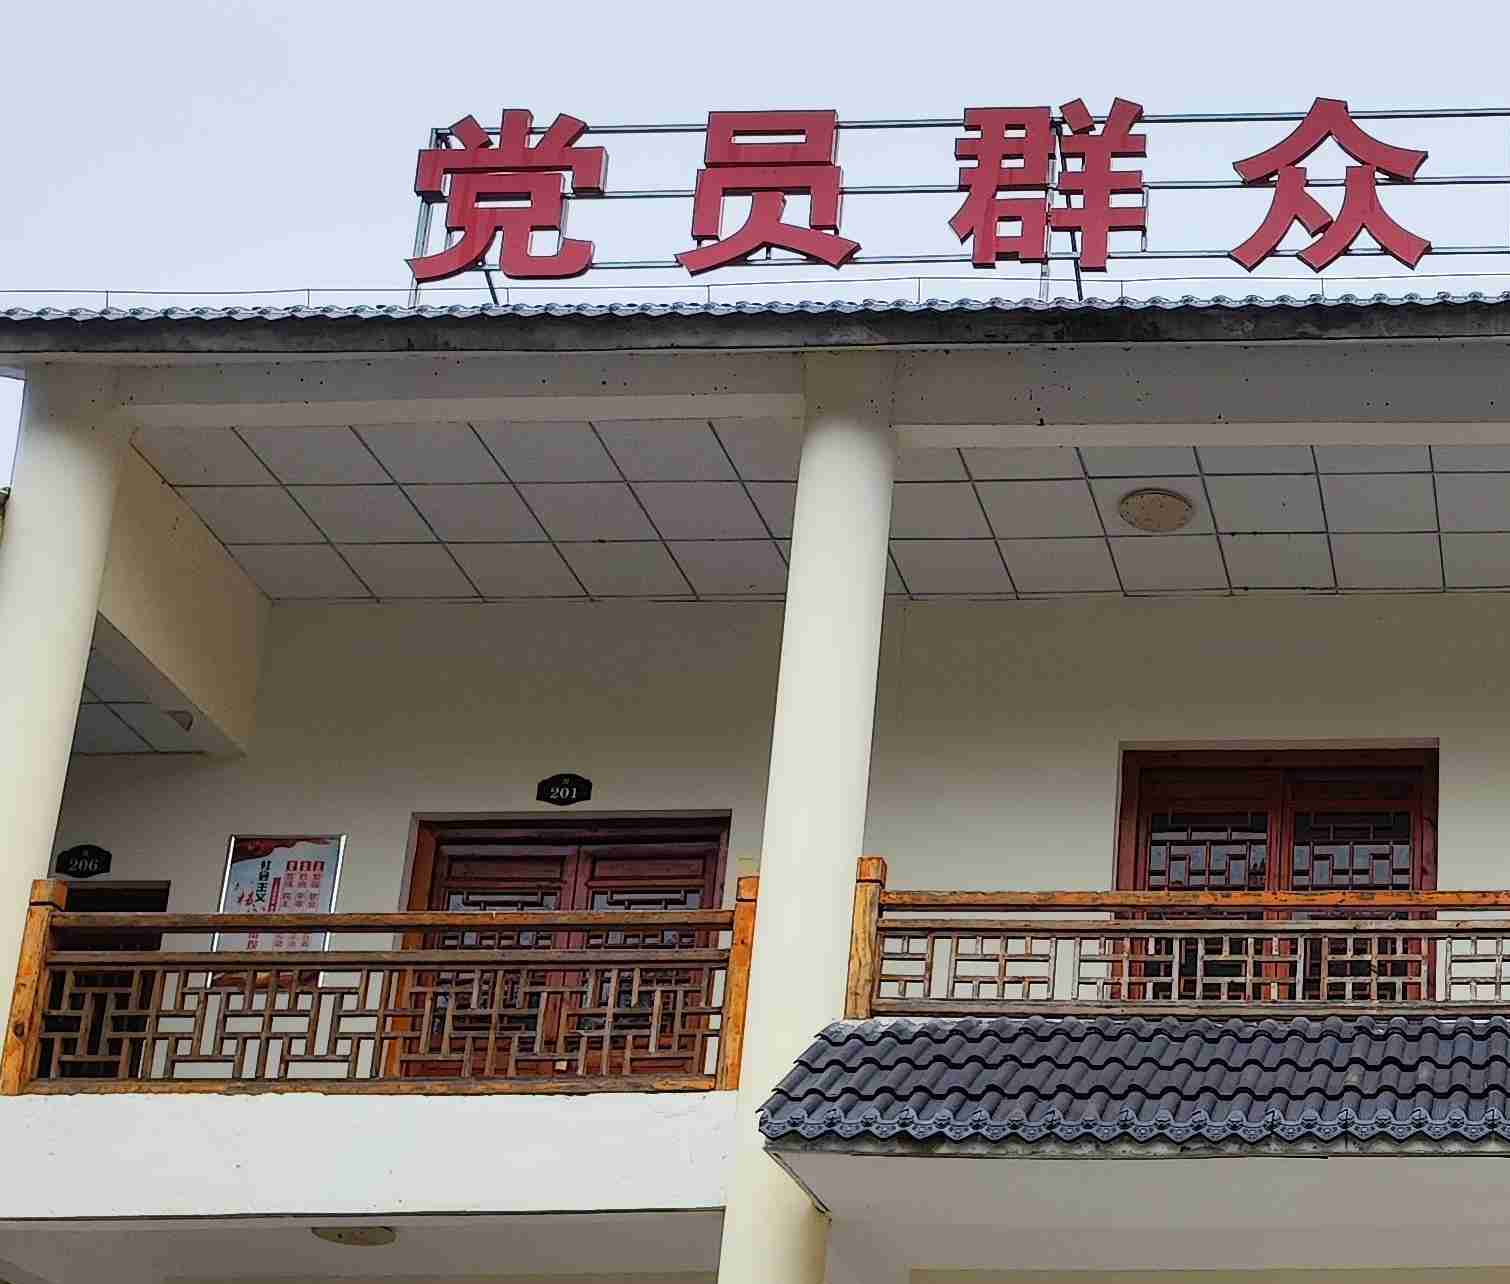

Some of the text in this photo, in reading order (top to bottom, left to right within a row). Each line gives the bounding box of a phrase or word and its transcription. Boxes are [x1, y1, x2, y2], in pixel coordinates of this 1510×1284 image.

[406, 96, 1432, 283] 党员群众
[549, 787, 577, 799] 201
[69, 858, 99, 872] 206
